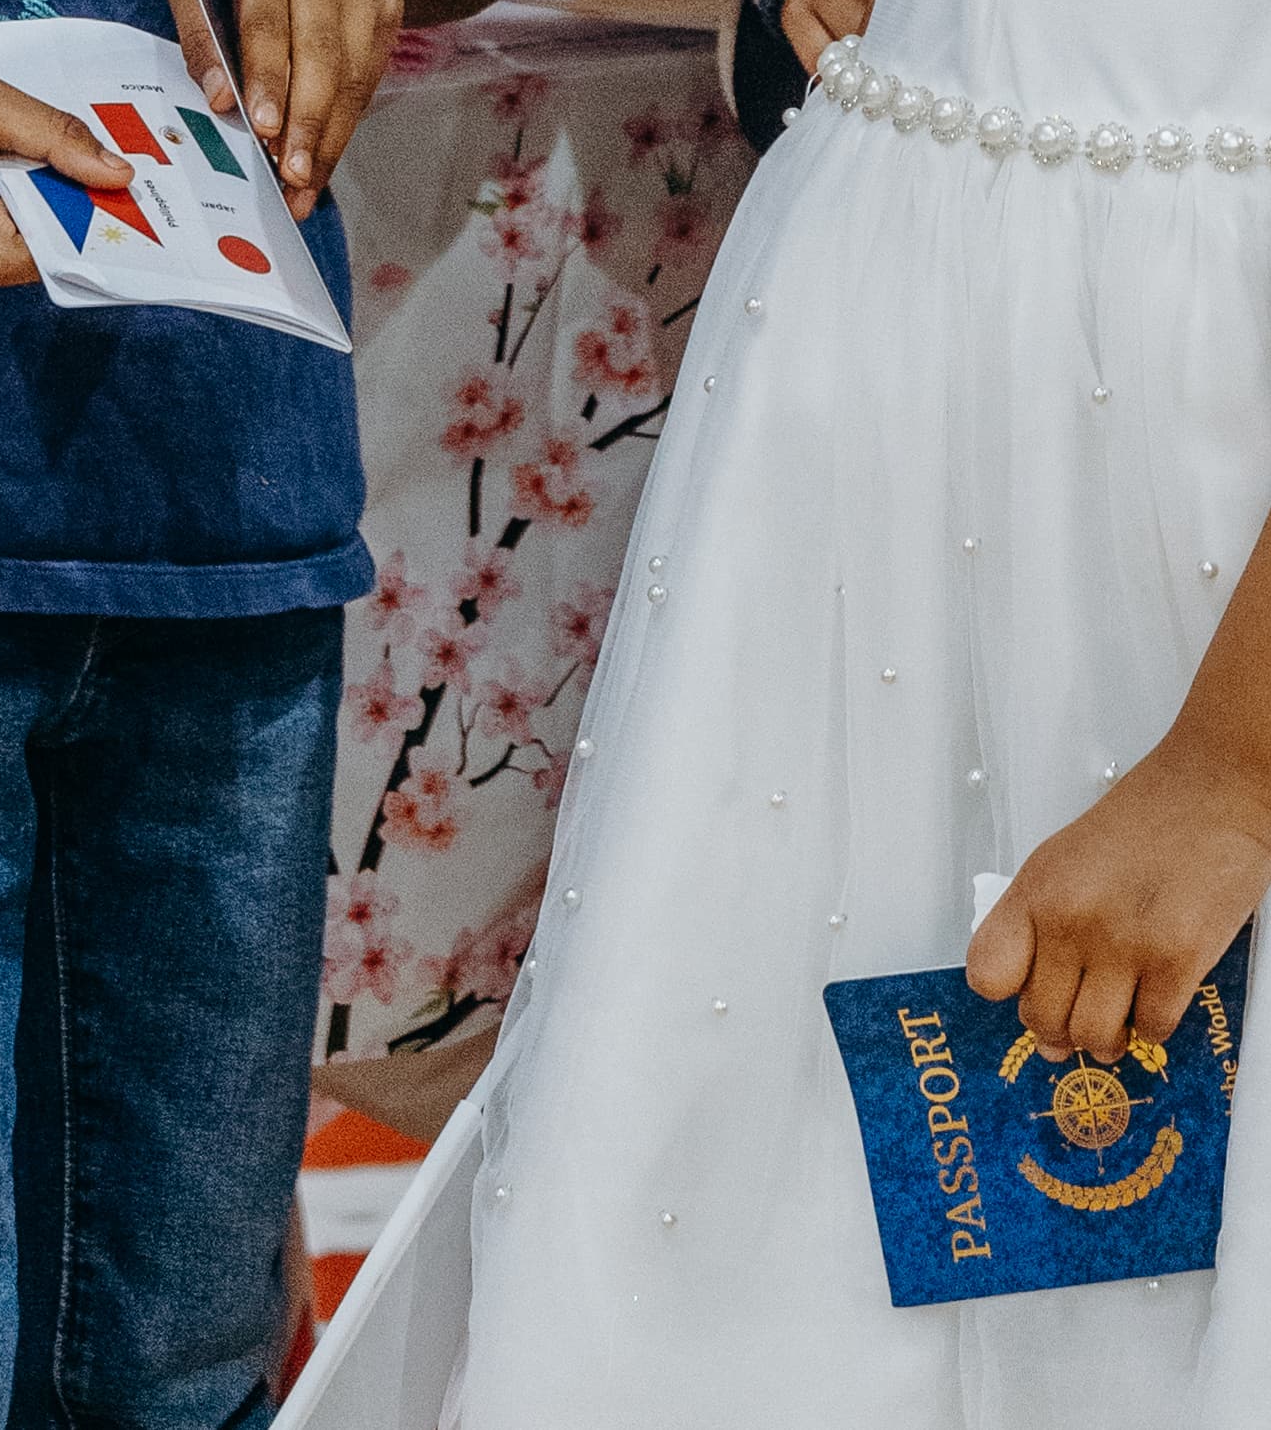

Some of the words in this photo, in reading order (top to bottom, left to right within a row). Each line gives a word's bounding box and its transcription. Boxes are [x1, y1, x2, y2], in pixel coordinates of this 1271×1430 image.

[121, 83, 165, 94] Mexico
[144, 179, 179, 228] Philippines
[201, 201, 236, 214] Japan
[1199, 983, 1233, 1056] World
[896, 1007, 992, 1263] PASSPORT
